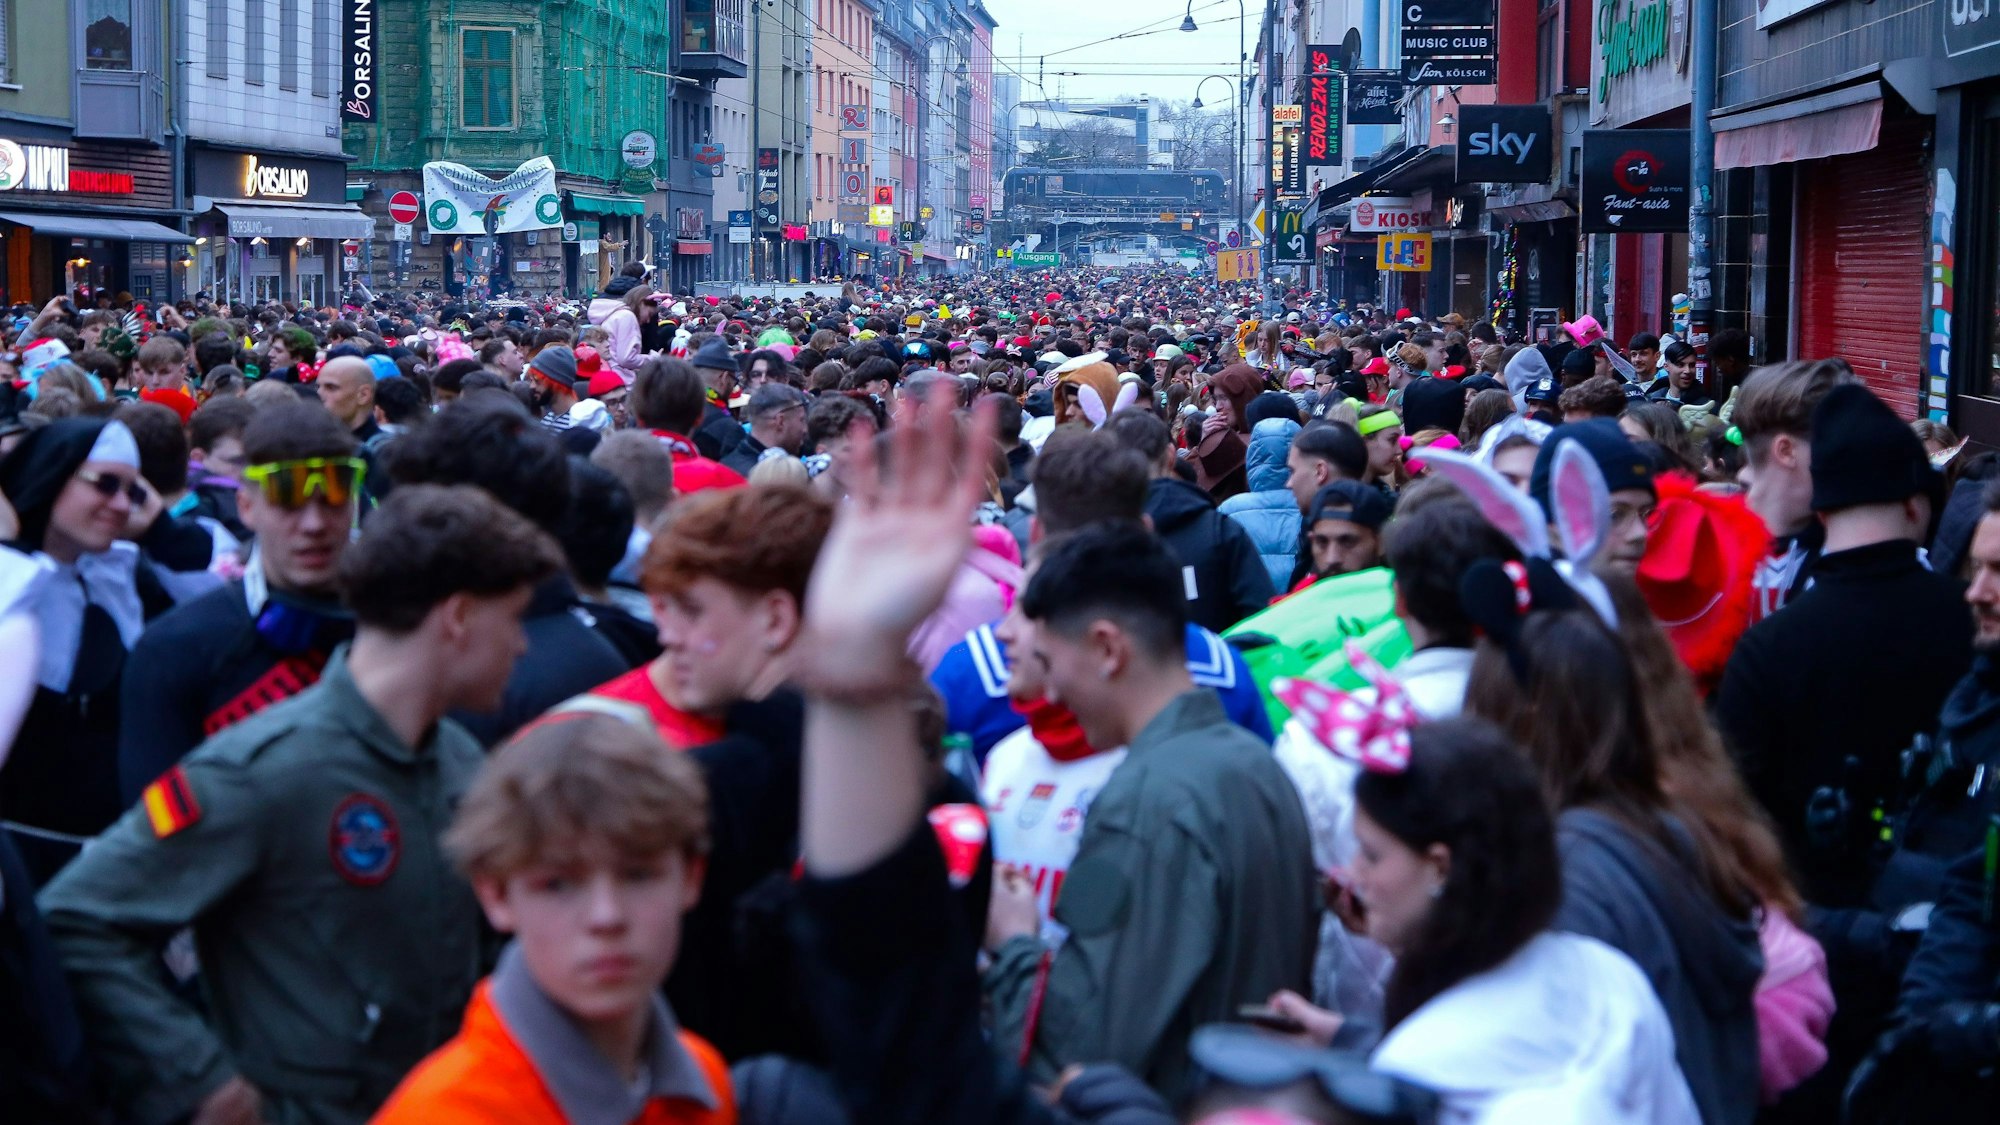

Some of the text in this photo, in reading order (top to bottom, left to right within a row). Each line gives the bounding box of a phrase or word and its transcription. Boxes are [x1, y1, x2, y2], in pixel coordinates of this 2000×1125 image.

[1405, 38, 1487, 48] MUSIC CLUB
[1408, 62, 1486, 81] Sion KÖLSCH
[1310, 51, 1328, 159] RENDEZVUS
[1468, 122, 1537, 164] sky
[244, 155, 309, 197] BORSALINO
[1603, 194, 1671, 210] Fant-asia
[1378, 212, 1432, 228] KIOSK
[1017, 253, 1055, 262] Ausgang
